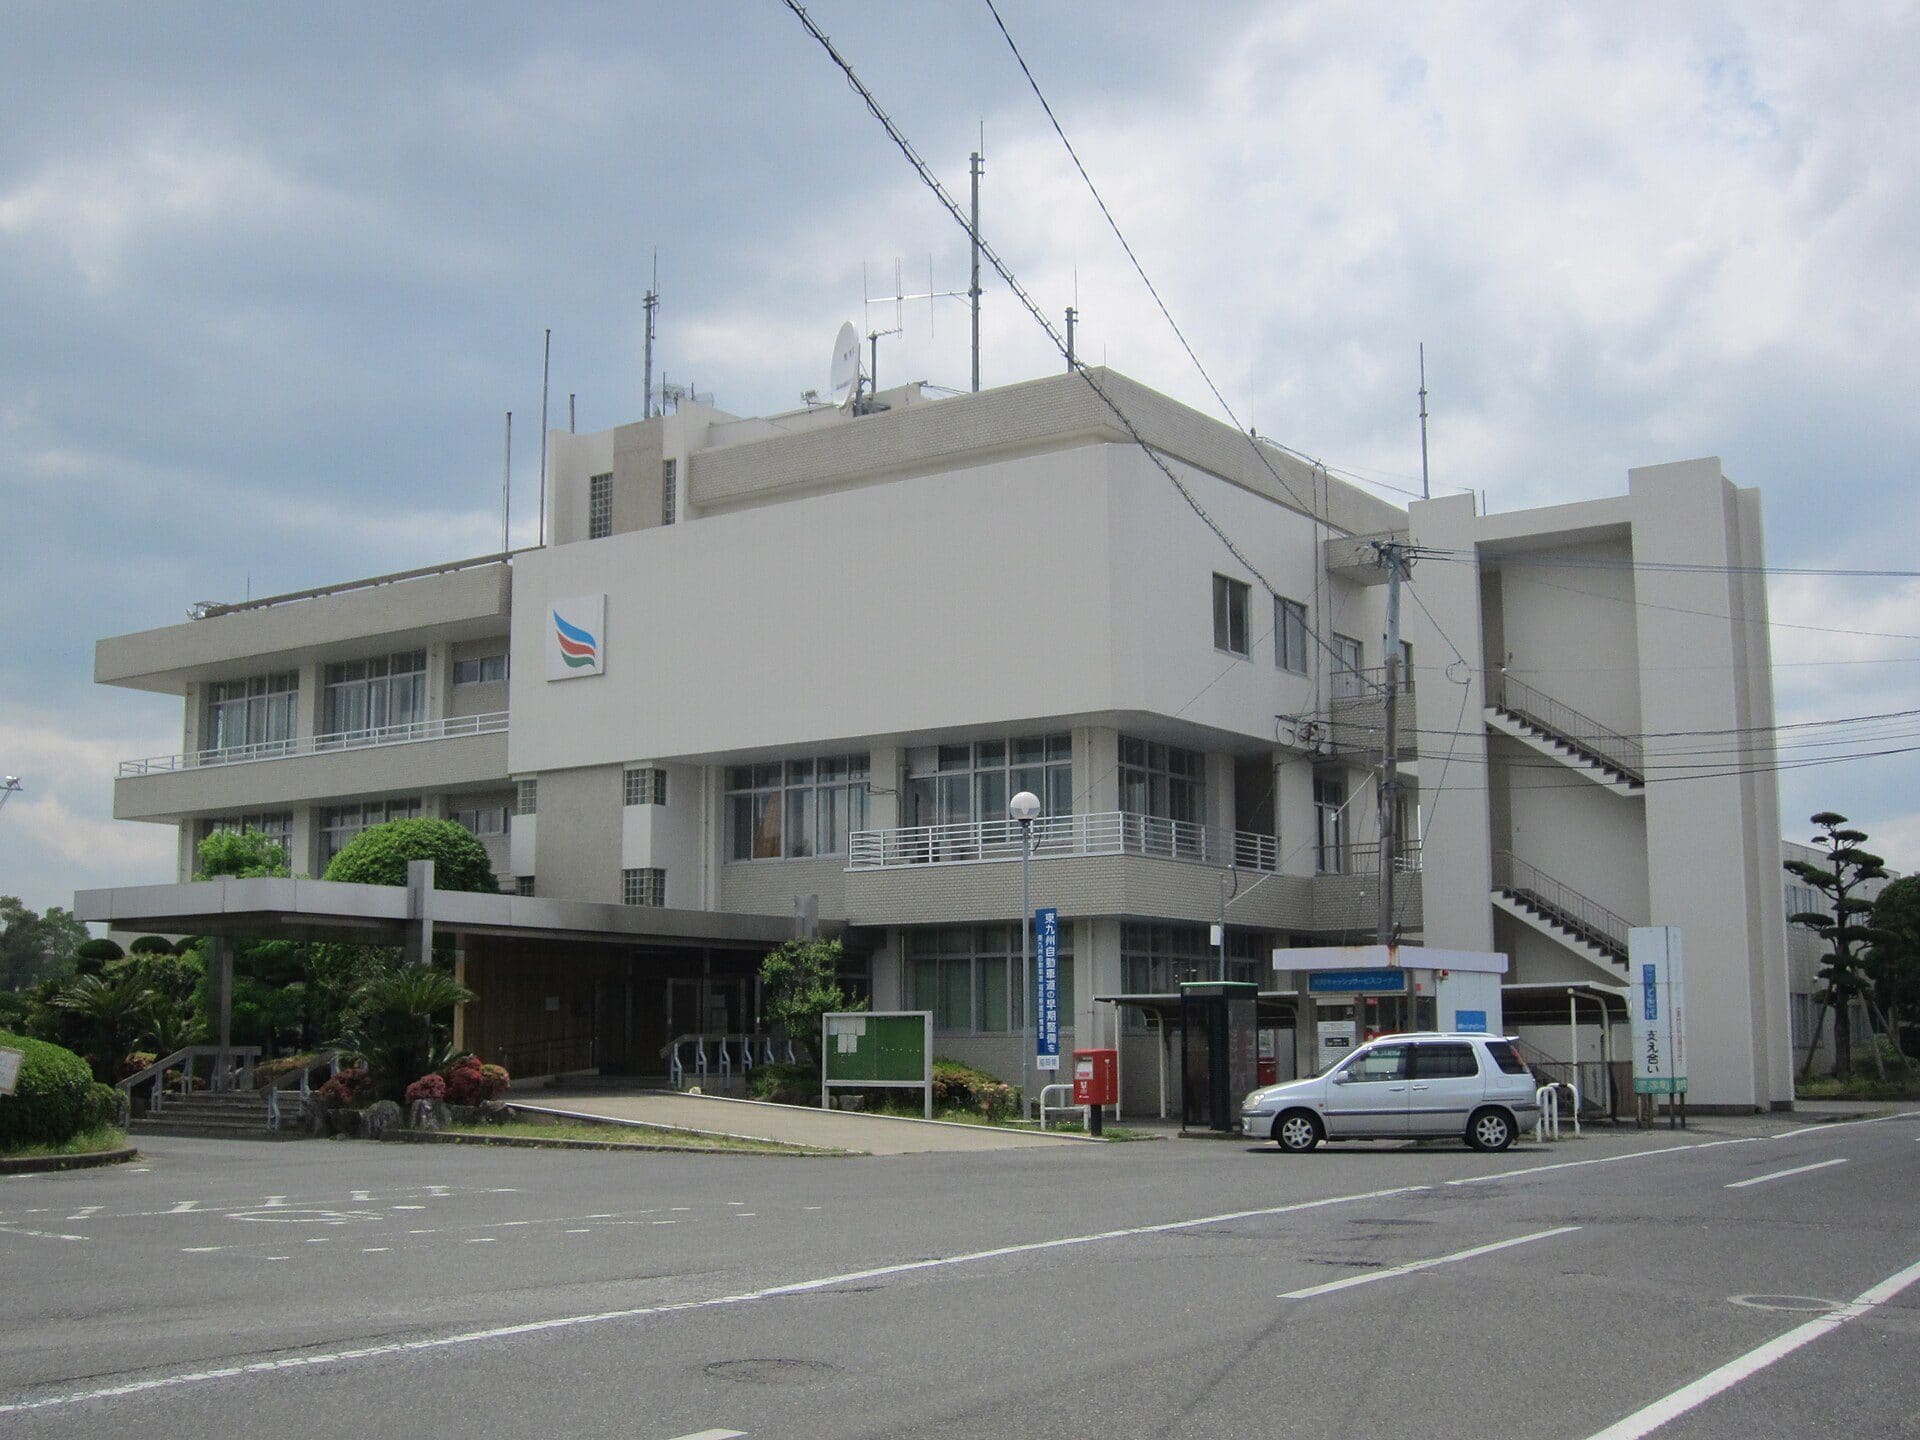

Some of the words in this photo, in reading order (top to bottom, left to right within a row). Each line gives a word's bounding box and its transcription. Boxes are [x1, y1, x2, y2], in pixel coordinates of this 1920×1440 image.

[1045, 912, 1057, 1053] 東九州自動車道の早期整備を
[1646, 1030, 1659, 1073] 支え合い
